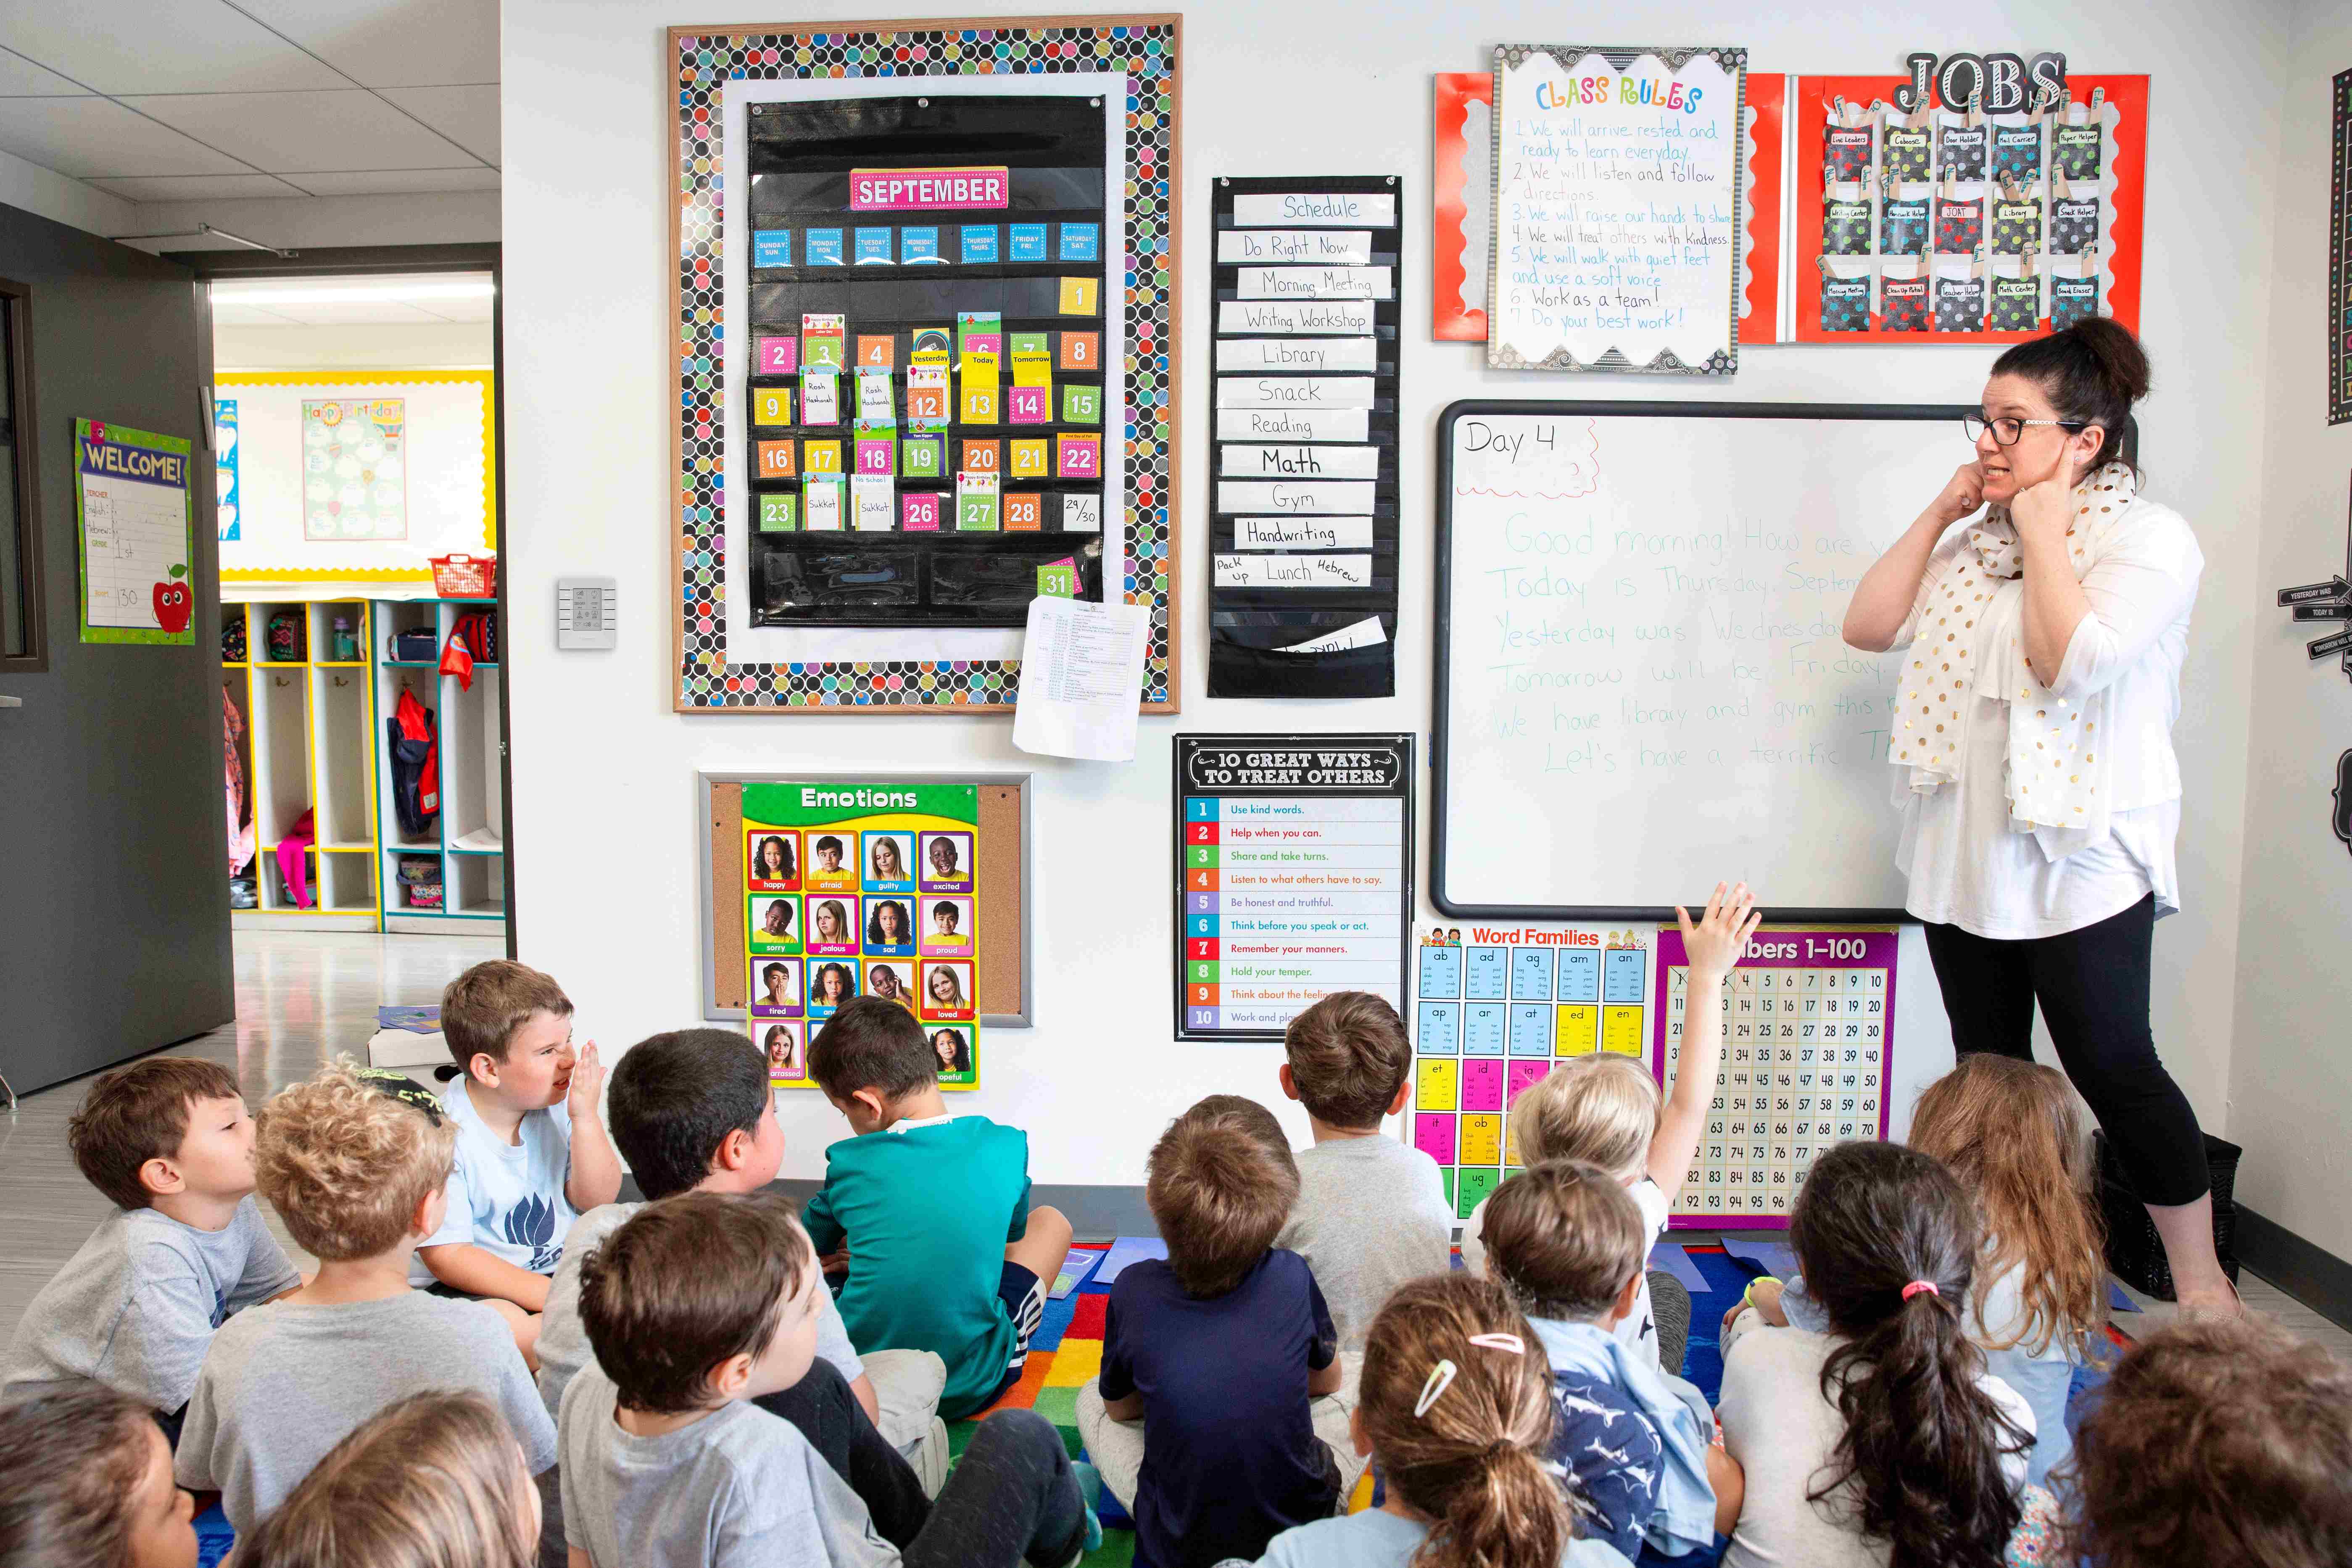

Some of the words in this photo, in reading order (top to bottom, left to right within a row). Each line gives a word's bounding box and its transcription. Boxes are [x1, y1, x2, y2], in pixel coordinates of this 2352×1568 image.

[1536, 76, 1609, 110] CLASS
[1621, 77, 1702, 113] RULES
[1899, 59, 2060, 110] JOBS
[1530, 120, 1553, 136] We
[1560, 118, 1581, 136] will
[1588, 126, 1632, 137] arrive
[1637, 117, 1682, 137] rested
[1690, 121, 1718, 139] and
[1522, 139, 1559, 163] ready
[1566, 139, 1579, 157] to
[1585, 138, 1618, 158] learn
[859, 177, 1000, 203] SEPTEMBER
[1284, 196, 1360, 218] Schedule
[1245, 235, 1261, 256] Do
[1272, 235, 1308, 262] Right
[1321, 236, 1348, 254] Now
[1263, 271, 1316, 298] Morning
[1324, 270, 1372, 298] Meeting
[1075, 287, 1083, 306] 1
[1532, 289, 1569, 306] Work
[1574, 294, 1591, 306] as
[1599, 295, 1609, 306] a
[1618, 287, 1659, 307] team!
[1245, 307, 1293, 332] Writing
[1300, 307, 1366, 332] Workshop
[1532, 308, 1552, 326] Do
[1561, 316, 1587, 336] your
[1597, 310, 1631, 328] best
[1638, 308, 1682, 329] work!
[1074, 342, 1085, 361] 8
[1263, 343, 1324, 369] Library
[1259, 379, 1321, 401] Snack
[303, 404, 342, 420] Happy
[343, 402, 403, 418] Birthday!
[1252, 413, 1312, 439] Reading
[1464, 422, 1524, 463] Day
[1537, 425, 1554, 450] 4
[86, 443, 182, 485] WELCOME!
[865, 450, 885, 468] 18
[1263, 448, 1321, 474] Math
[87, 490, 108, 498] TEACHER
[1273, 485, 1314, 512] Gym
[909, 504, 932, 522] 26
[92, 540, 108, 548] GRADE
[1248, 522, 1336, 546] Handwriting
[1506, 514, 1593, 555] Good
[1614, 514, 1730, 566] morning!
[1745, 518, 1799, 551] How
[1815, 535, 1851, 556] are
[1267, 559, 1312, 581] Lunch
[1318, 560, 1359, 582] Hebrew
[1046, 574, 1065, 594] 31
[117, 589, 137, 606] 130
[2291, 590, 2318, 599] YESTERDAY
[2314, 640, 2338, 653] TOMORROW
[1489, 664, 1622, 693] Tomorrow
[1652, 661, 1705, 682] will
[1733, 664, 1761, 681] be
[1219, 754, 1240, 767] 10
[1247, 754, 1311, 767] GREAT
[1318, 754, 1371, 767] WAYS
[1205, 770, 1233, 784] TO
[1238, 770, 1302, 784] TREAT
[1308, 770, 1385, 784] OTHERS
[801, 788, 917, 808] Emotions
[1231, 805, 1247, 814] Use
[1251, 804, 1270, 814] kind
[1274, 805, 1304, 814] words.
[764, 881, 786, 891] happy
[878, 882, 899, 891] guilty
[1231, 898, 1242, 907] Be
[1245, 898, 1275, 907] honest
[1278, 898, 1295, 907] and
[1298, 897, 1333, 907] truthful.
[1473, 928, 1520, 944] Word
[1525, 929, 1599, 945] Families
[820, 944, 846, 954] jealous
[1434, 949, 1448, 961] ab
[1527, 956, 1540, 967] ag
[1231, 967, 1252, 976] Hold
[1255, 969, 1276, 979] your
[1279, 968, 1312, 979] temper.
[1867, 1025, 1879, 1037] 30
[1755, 1098, 1767, 1109] 55
[1772, 1196, 1784, 1208] 96
